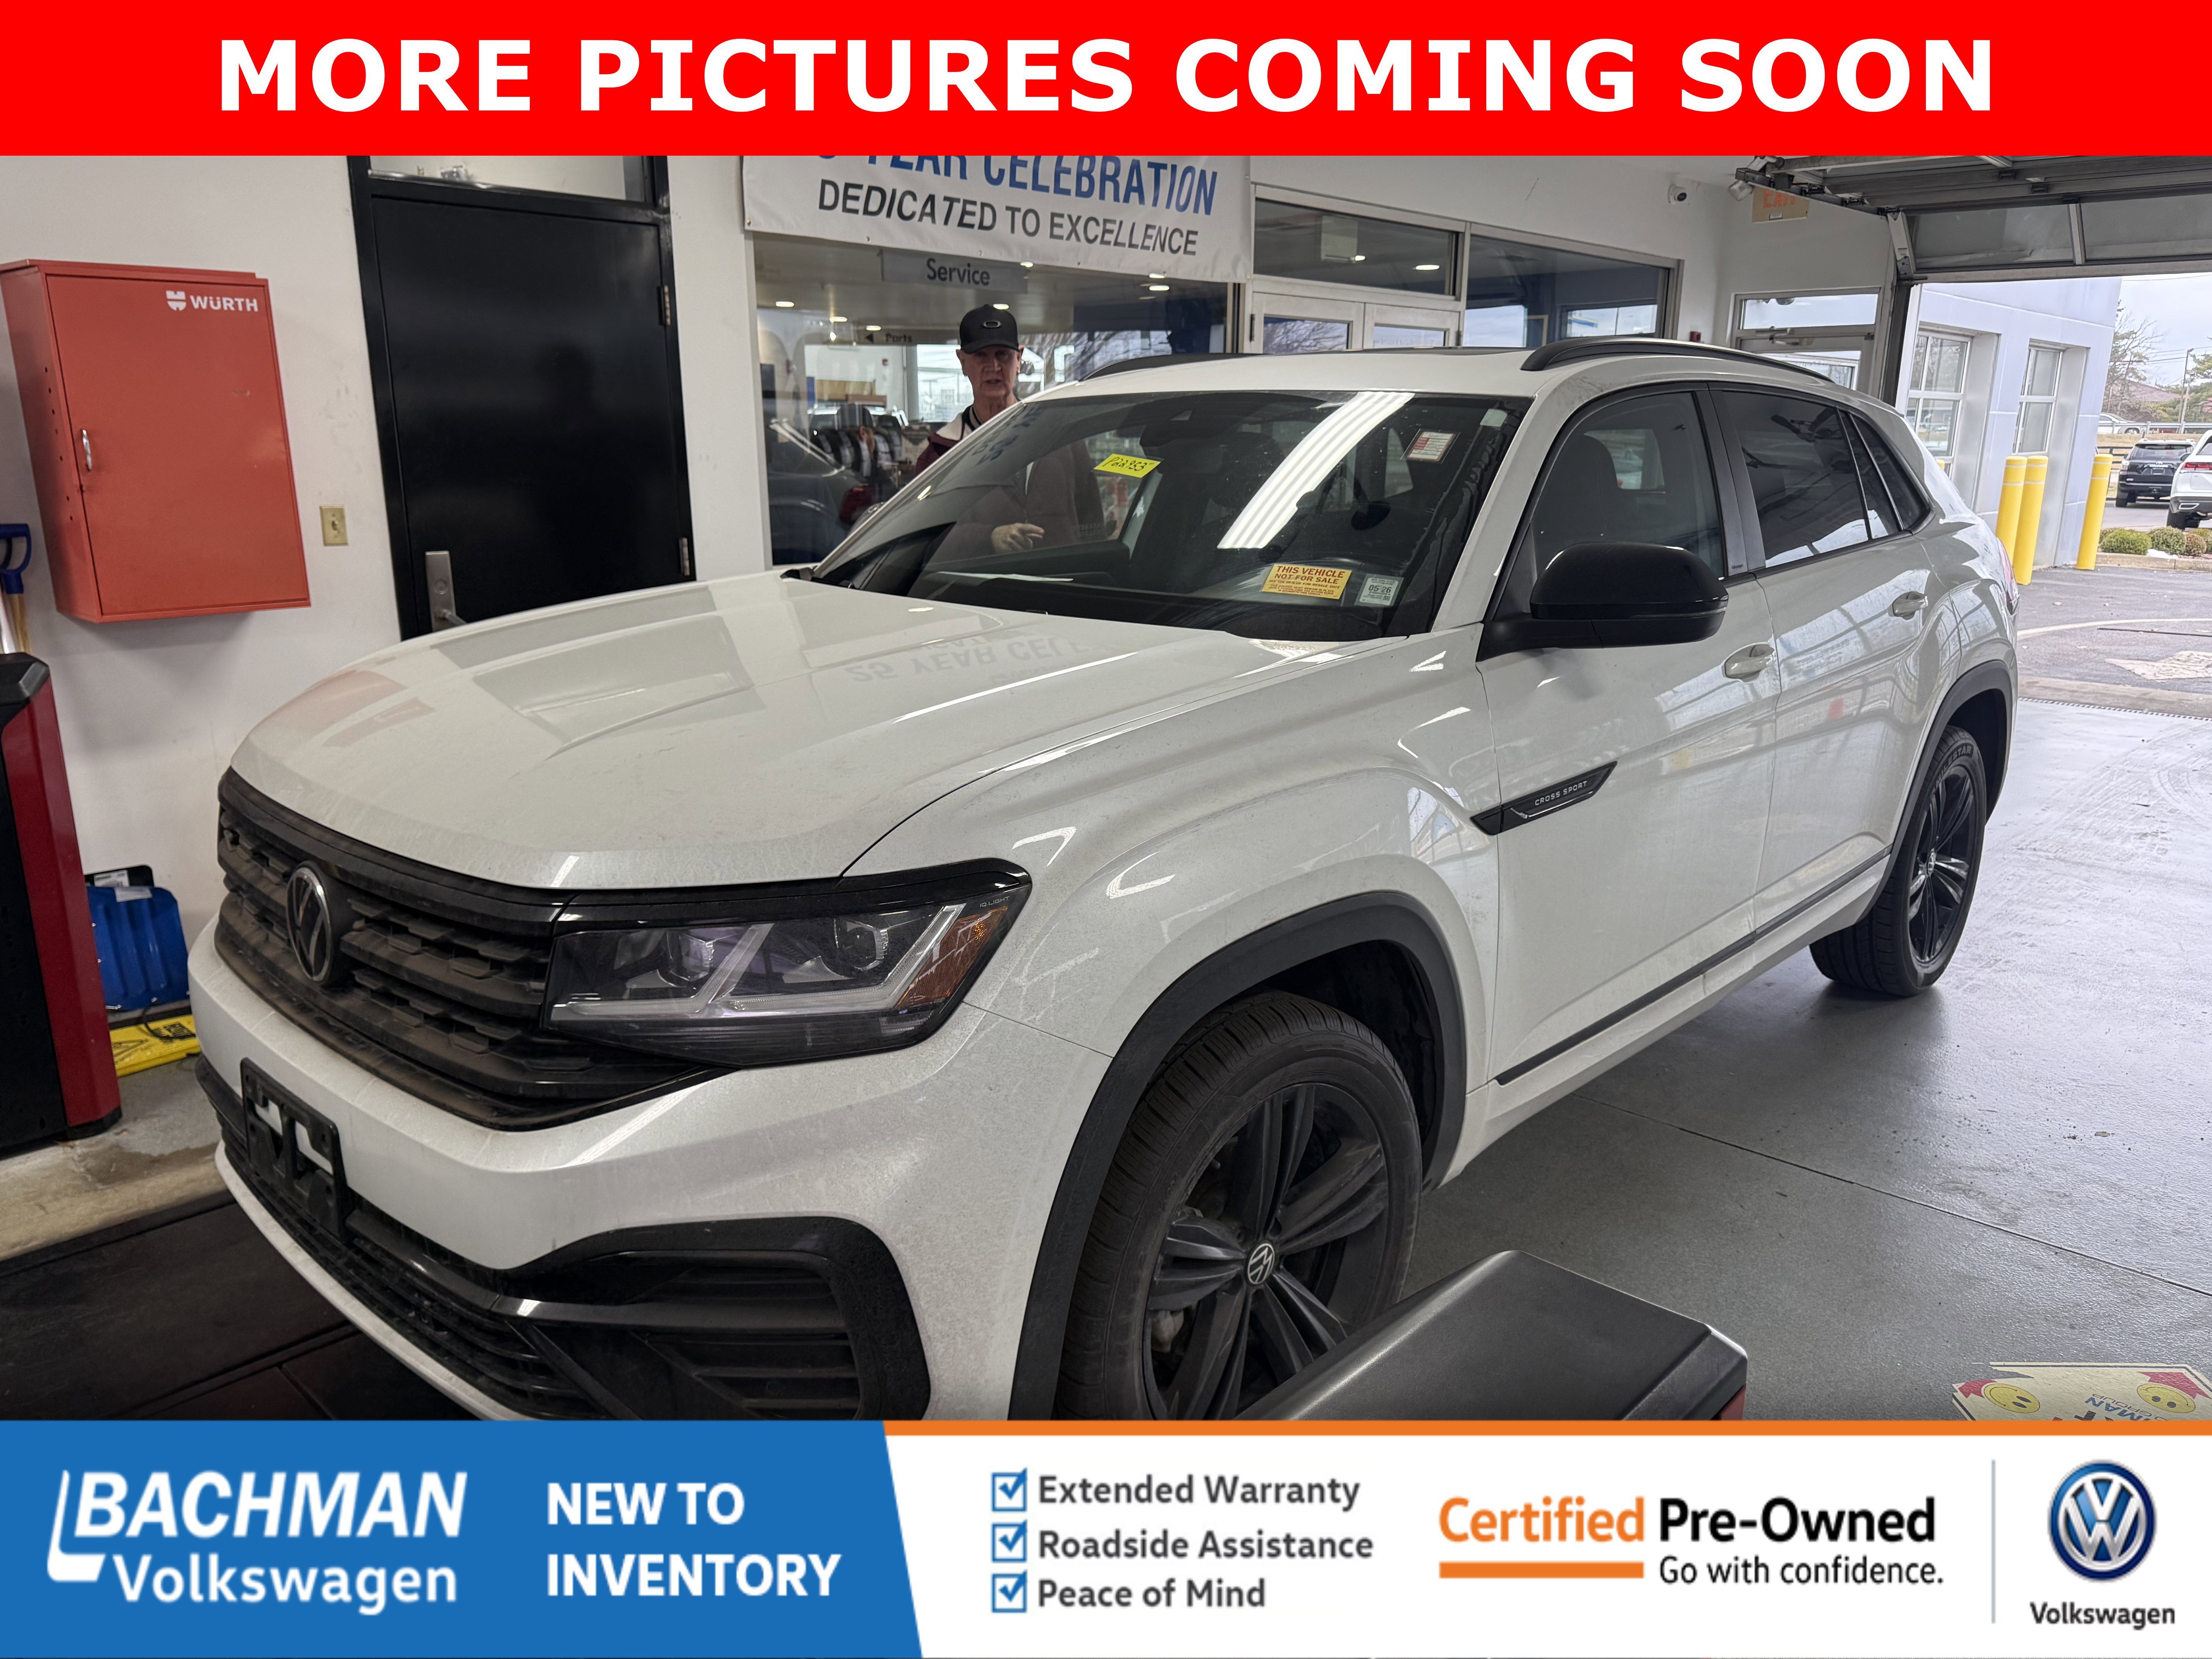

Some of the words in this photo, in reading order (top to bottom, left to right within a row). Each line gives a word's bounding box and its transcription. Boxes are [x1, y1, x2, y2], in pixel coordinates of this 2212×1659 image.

[984, 156, 1217, 216] CELEBRATION
[819, 179, 996, 231] DEDICATED
[1006, 206, 1040, 237] TO
[1049, 212, 1198, 256] EXCELLENCE
[927, 258, 990, 286] Service
[190, 295, 258, 312] WÜRTH
[1302, 567, 1345, 578] VEHICLE
[1535, 792, 1560, 806] CROSS
[1563, 781, 1587, 795] SPORT
[980, 896, 1010, 907] IQ.LIGHT
